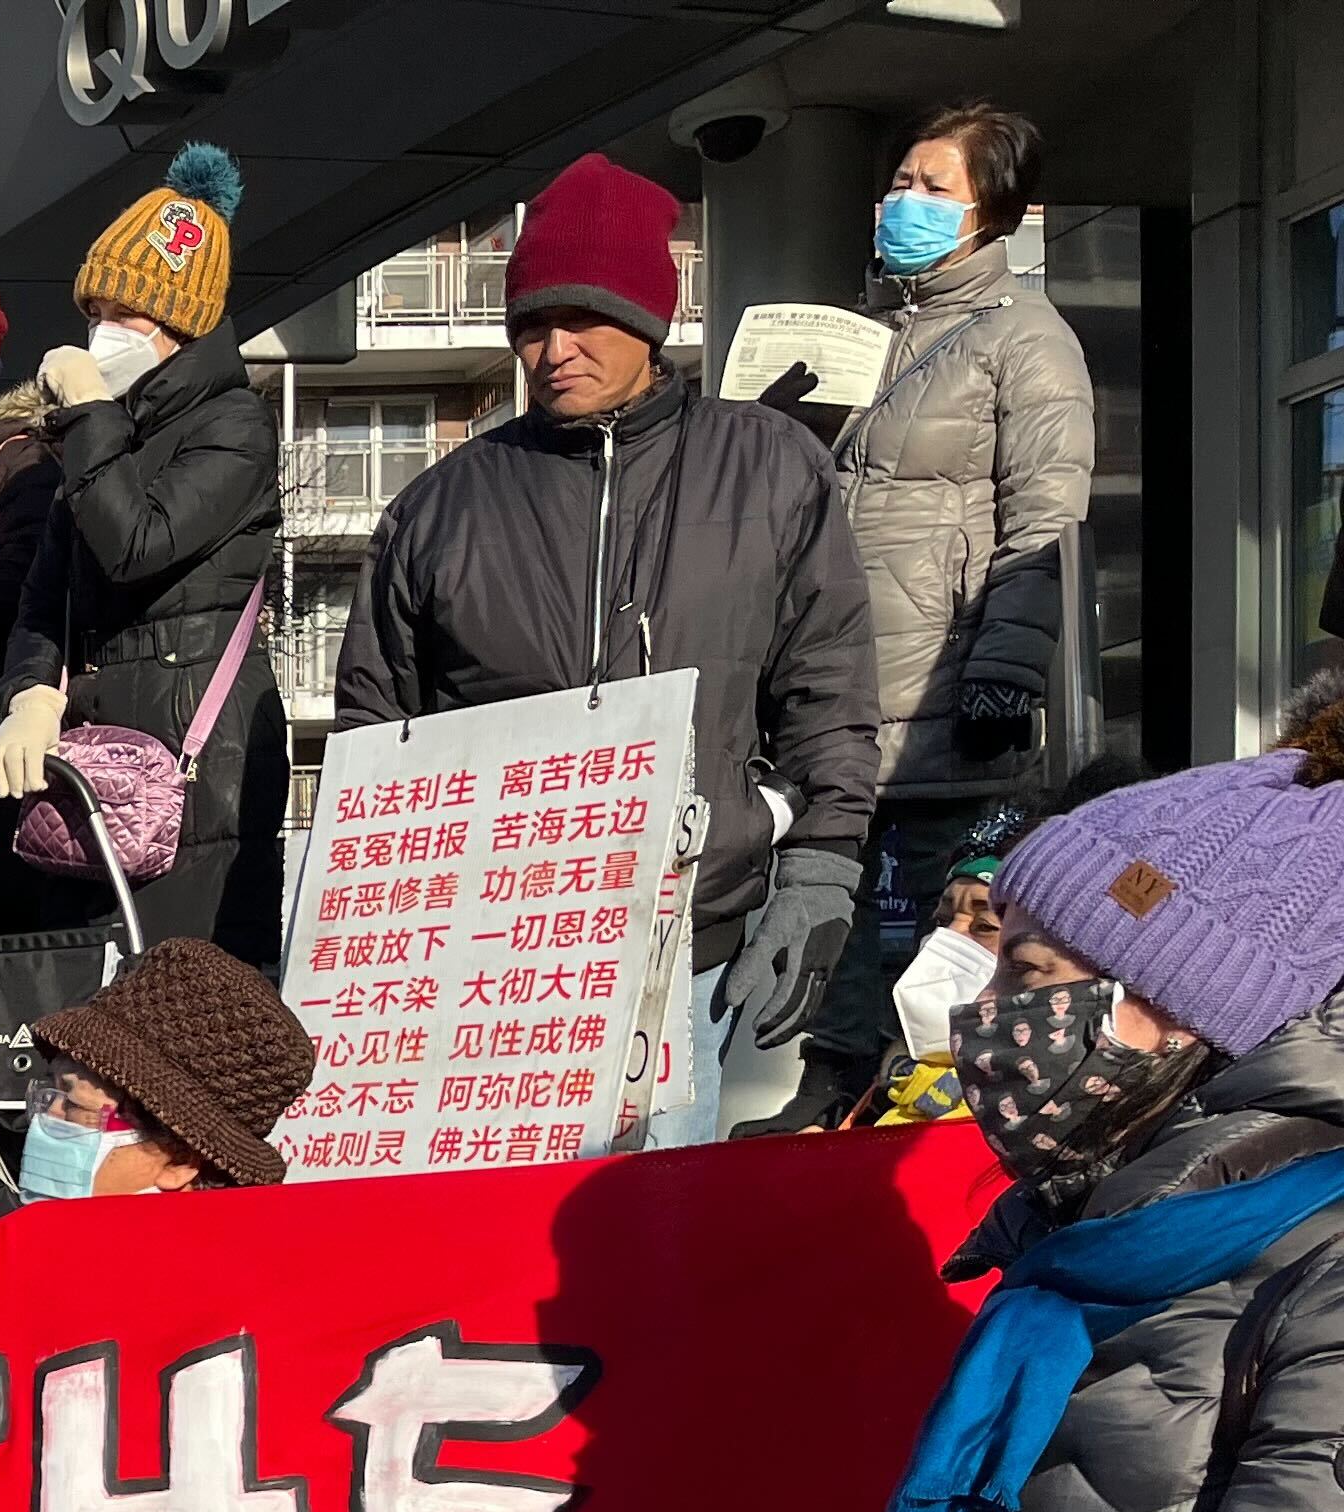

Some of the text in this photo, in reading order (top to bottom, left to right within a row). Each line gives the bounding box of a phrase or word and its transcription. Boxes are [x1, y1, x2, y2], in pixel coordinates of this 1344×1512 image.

[165, 219, 203, 255] P
[336, 740, 656, 824] 弘法利生 离苦得乐
[326, 821, 470, 874] 冤冤相报
[491, 796, 650, 853] 苦海无边
[317, 850, 640, 923] 断恶修善 功德无量
[309, 924, 451, 973] 看破放下
[471, 906, 629, 953] 一切恩怨
[299, 960, 620, 1018] 一尘不染 大彻大悟
[447, 1014, 607, 1062] 见性成佛
[437, 1068, 596, 1113] 阿弥陀佛
[427, 1123, 585, 1165] 佛光普照
